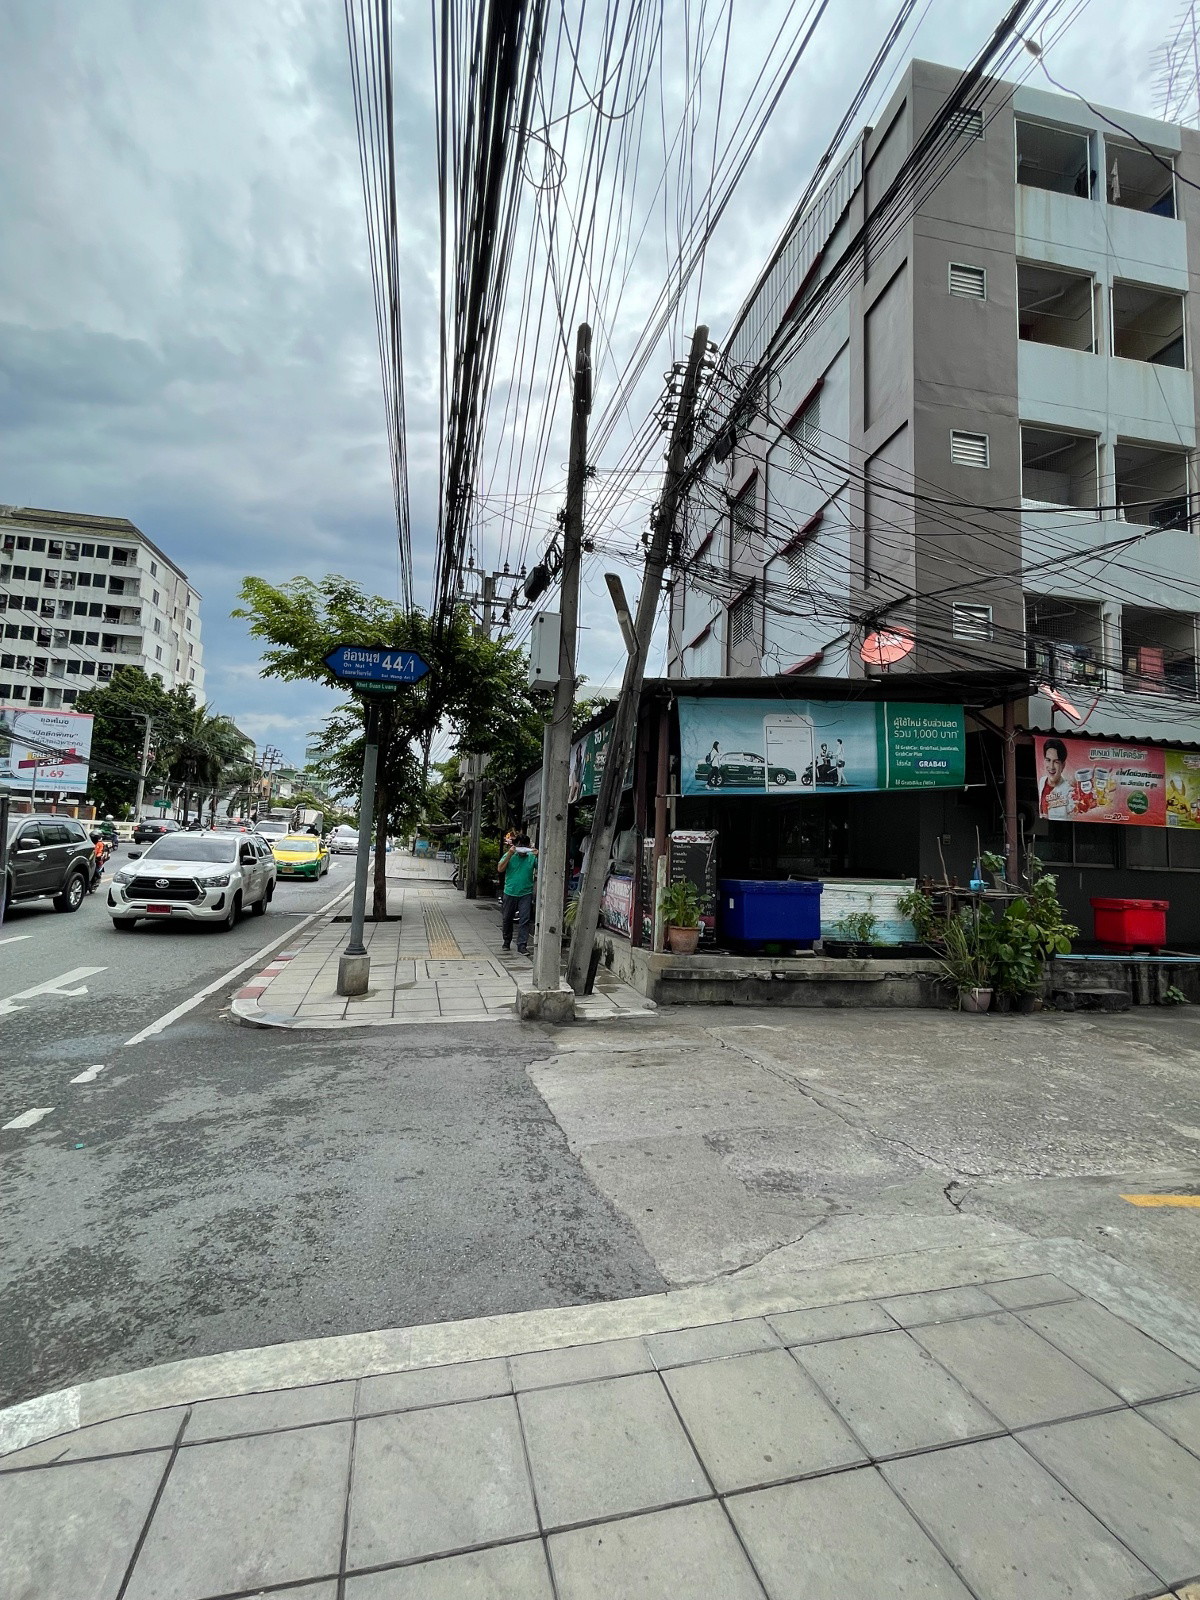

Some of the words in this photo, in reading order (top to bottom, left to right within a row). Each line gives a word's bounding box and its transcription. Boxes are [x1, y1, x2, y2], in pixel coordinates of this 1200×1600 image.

[343, 648, 380, 667] อ่อนนุช
[381, 655, 415, 673] 44/1
[381, 683, 397, 691] Luang
[893, 717, 921, 729] ผู้ใช้ใหม่
[922, 719, 958, 728] รับส่วนลด
[894, 730, 912, 738] รวม
[913, 729, 938, 739] 1,000
[918, 760, 947, 768] GRAB4U
